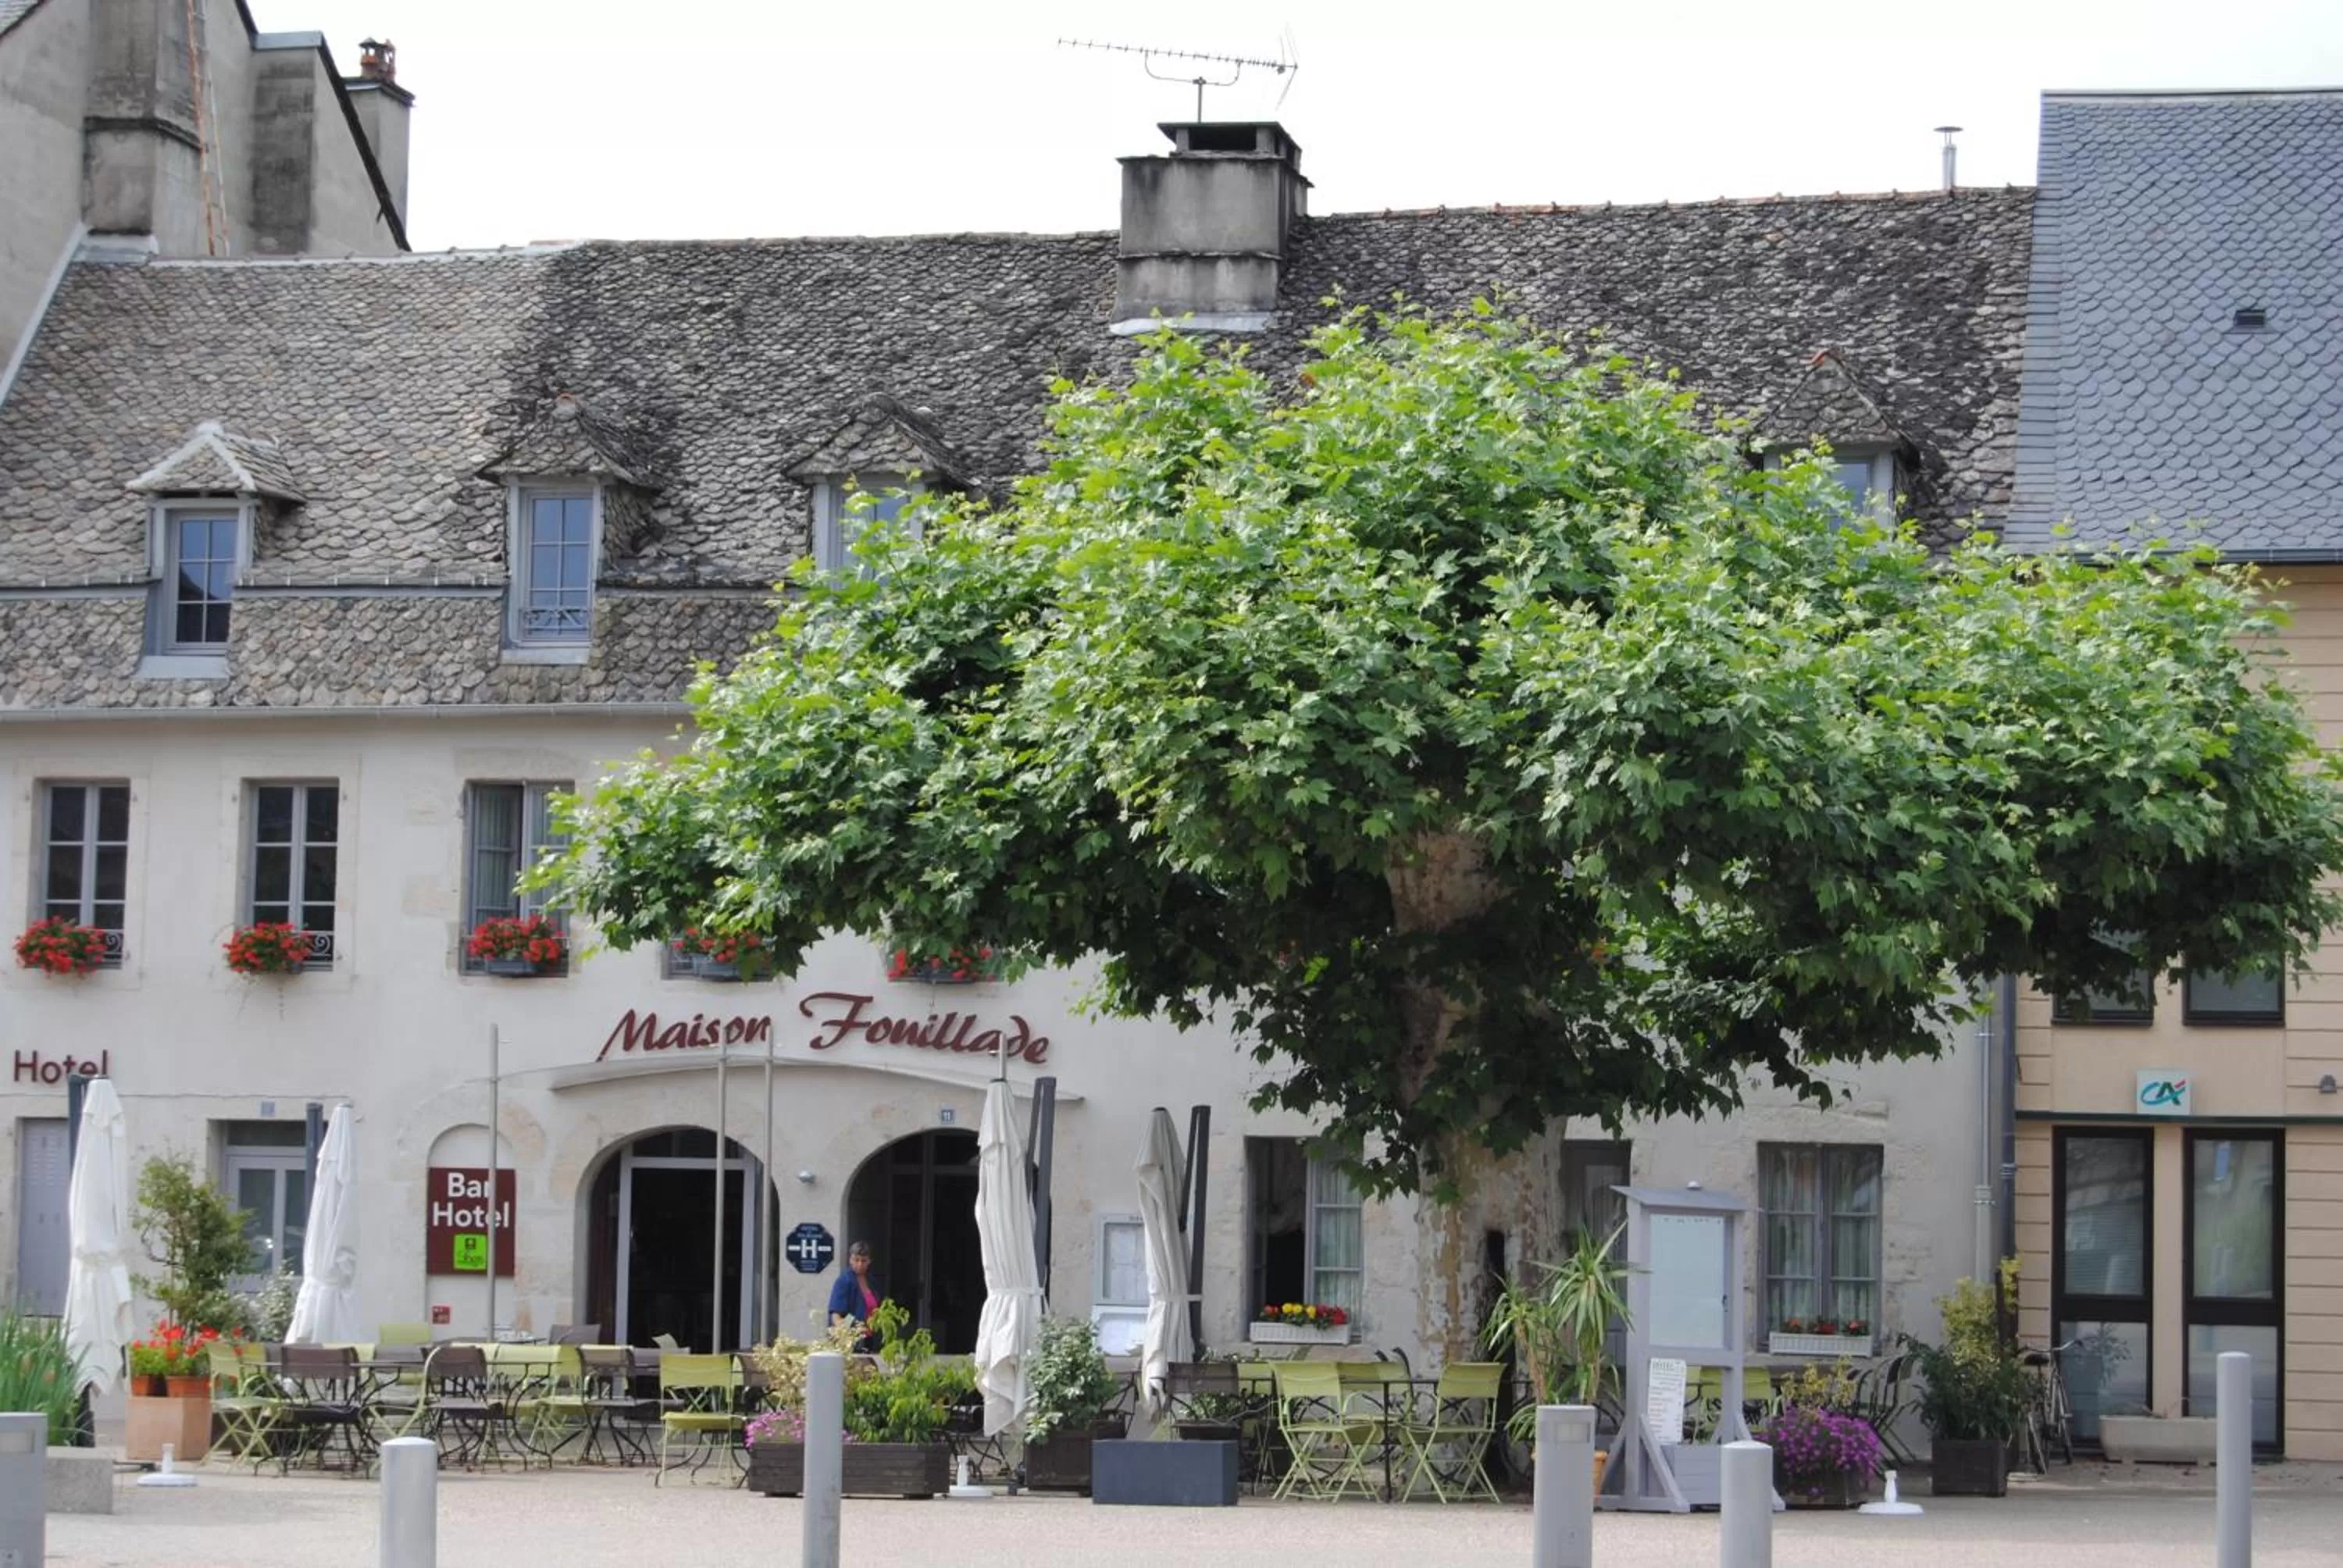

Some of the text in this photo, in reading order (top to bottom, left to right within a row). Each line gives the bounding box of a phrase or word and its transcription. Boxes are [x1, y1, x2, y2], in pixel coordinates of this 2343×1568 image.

[595, 992, 1050, 1064] Maison Fouillade
[801, 1238, 818, 1260] H
